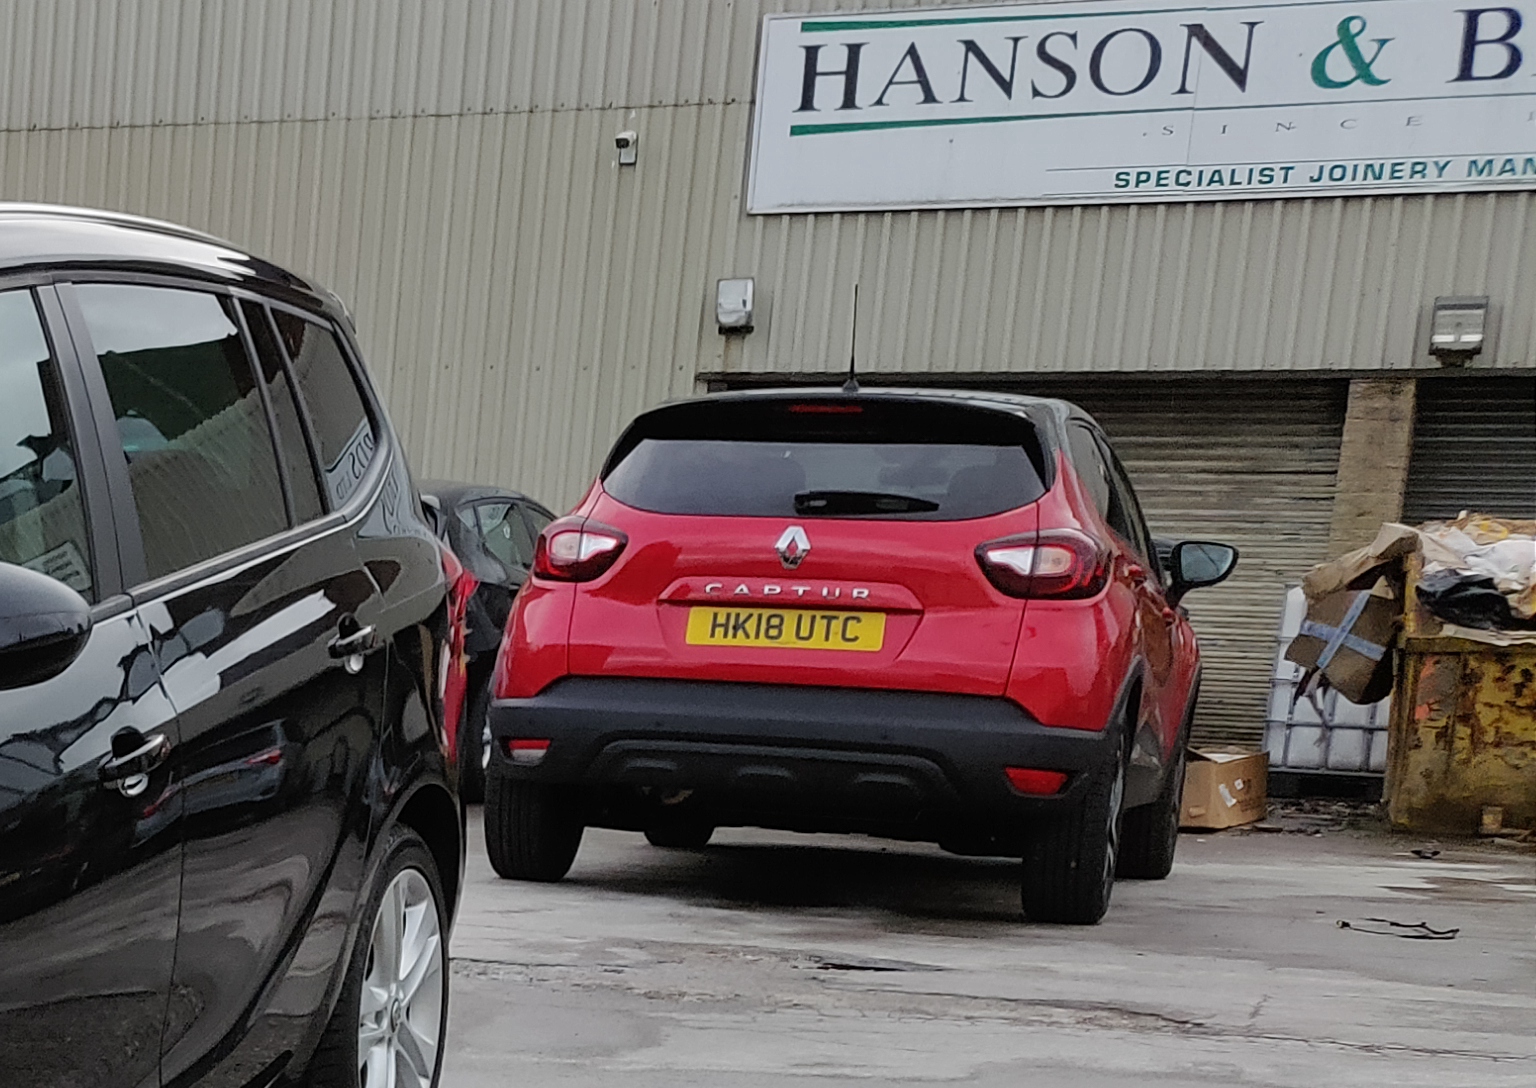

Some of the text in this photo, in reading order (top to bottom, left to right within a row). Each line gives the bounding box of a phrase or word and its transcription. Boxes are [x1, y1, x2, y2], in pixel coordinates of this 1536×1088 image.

[794, 6, 1536, 114] HANSON & B
[1161, 114, 1423, 137] SINCE
[1114, 166, 1295, 189] SPECIALIST
[1308, 160, 1453, 182] JOINERY
[705, 583, 870, 599] CAPTUR
[794, 613, 863, 643] UTC
